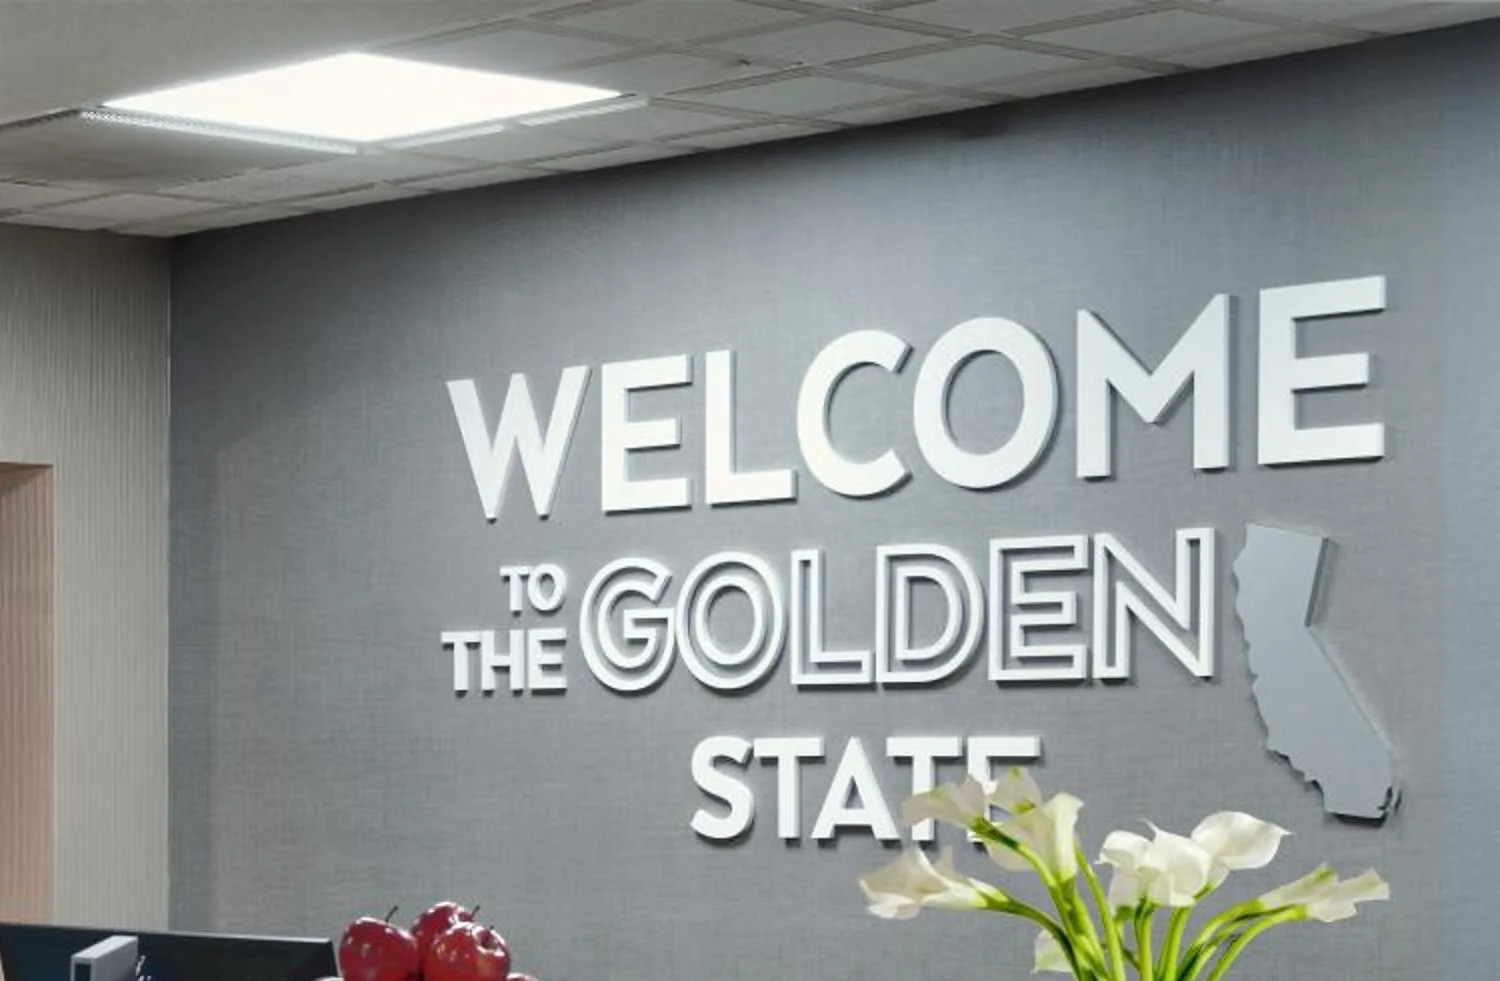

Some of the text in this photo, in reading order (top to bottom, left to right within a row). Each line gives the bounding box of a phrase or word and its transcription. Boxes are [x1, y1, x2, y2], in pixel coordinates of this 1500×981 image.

[447, 274, 1386, 522] WELCOME
[441, 526, 1216, 695] THE GOLDEN
[500, 564, 567, 613] TO
